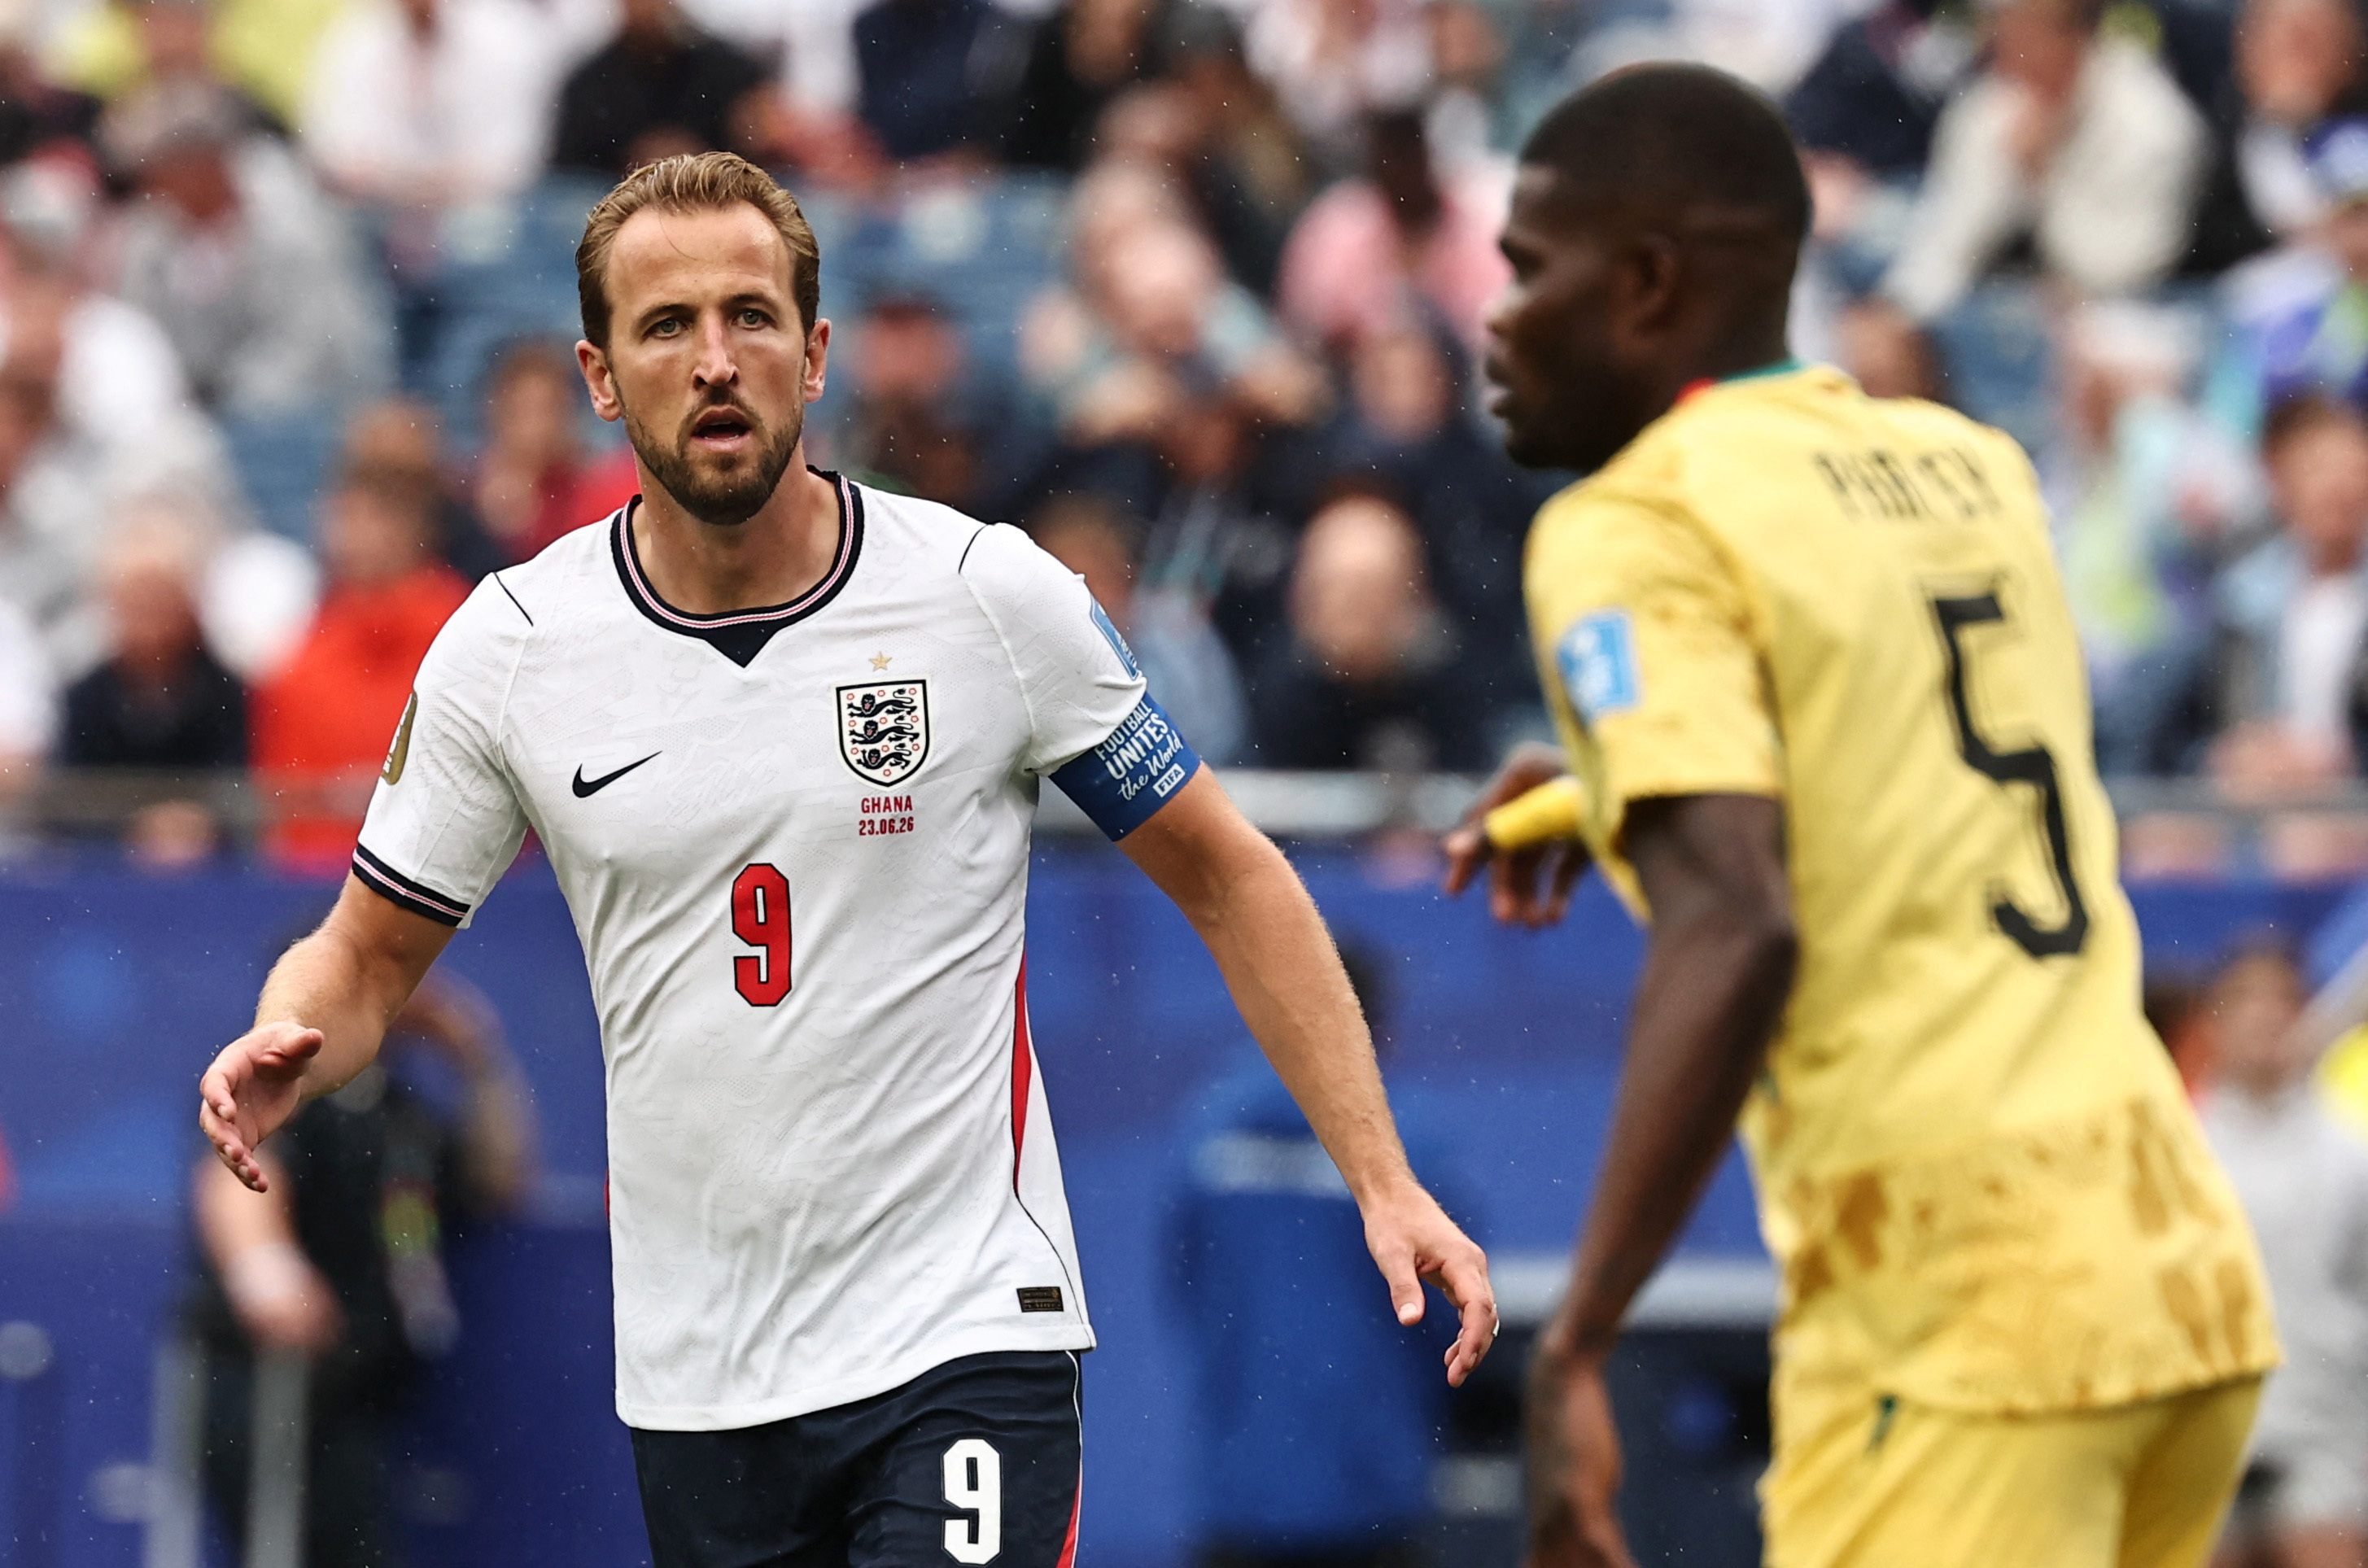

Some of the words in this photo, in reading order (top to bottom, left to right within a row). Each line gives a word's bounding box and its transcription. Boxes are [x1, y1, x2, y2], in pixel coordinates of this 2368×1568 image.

[1094, 700, 1153, 762] FOOTBALL
[1105, 713, 1169, 780] UNITES
[1117, 774, 1149, 801] the
[1144, 729, 1184, 777] World
[1156, 767, 1183, 794] FIFA
[1932, 593, 2090, 959] 5
[859, 816, 914, 836] 23.06.26
[861, 794, 913, 814] GHANA
[731, 863, 793, 1007] 9
[942, 1438, 1002, 1566] 9
